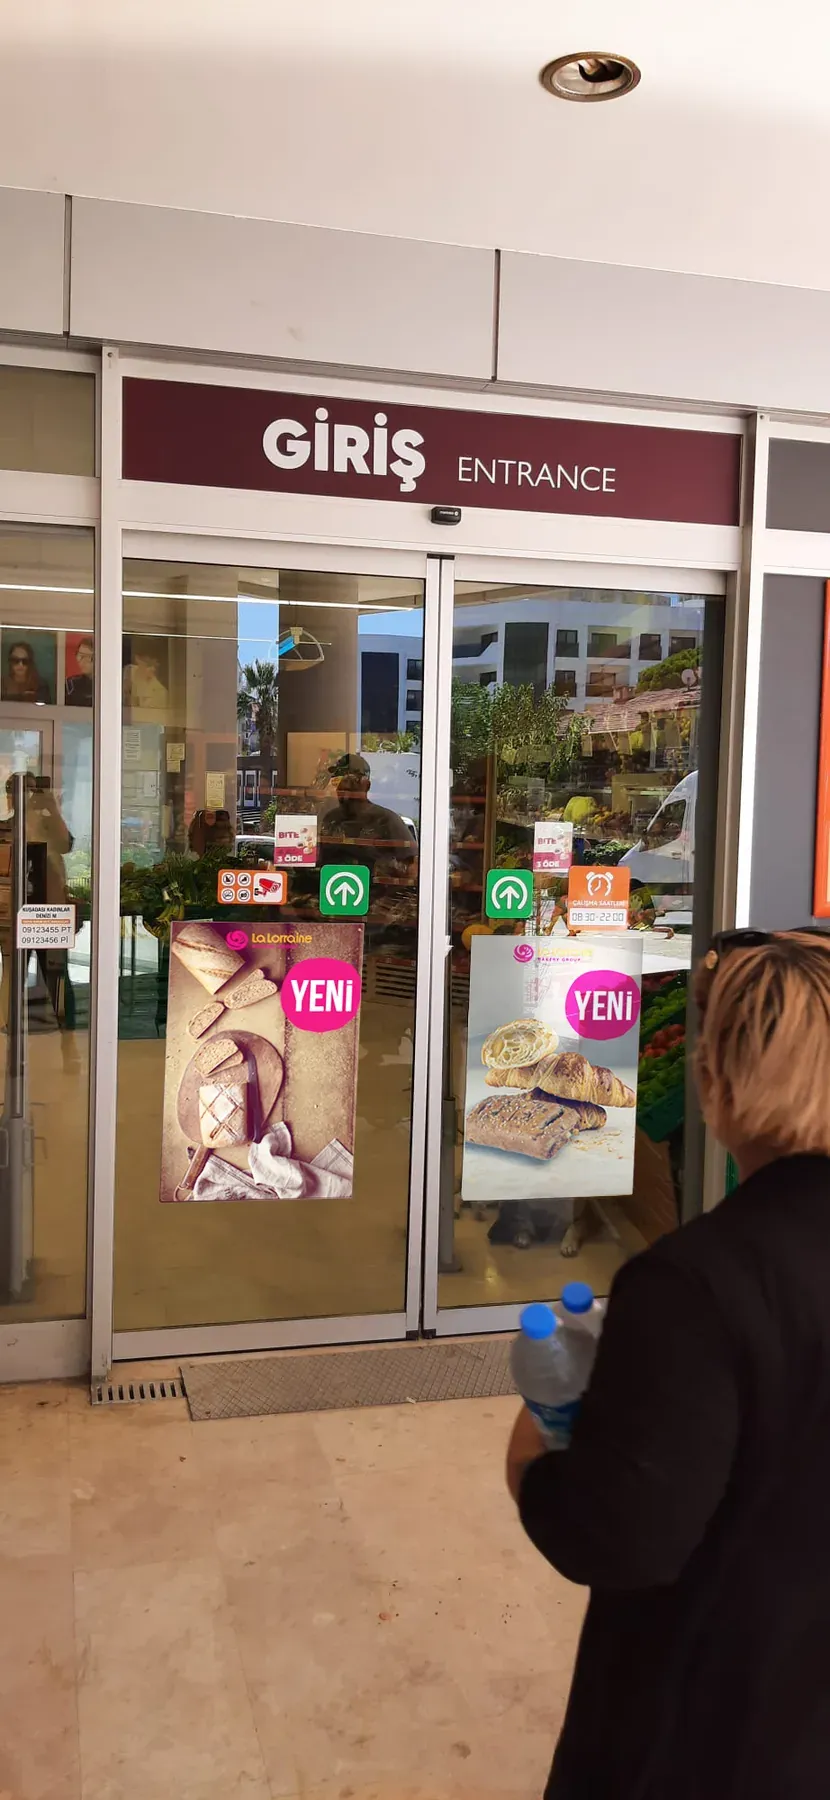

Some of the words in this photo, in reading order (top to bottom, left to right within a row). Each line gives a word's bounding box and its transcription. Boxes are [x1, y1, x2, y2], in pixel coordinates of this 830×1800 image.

[262, 407, 426, 492] GİRİŞ
[457, 456, 616, 492] ENTRANCE
[284, 853, 303, 862] ÖDE
[22, 926, 60, 934] 09123455
[251, 932, 266, 944] La
[267, 932, 313, 944] Lorraine
